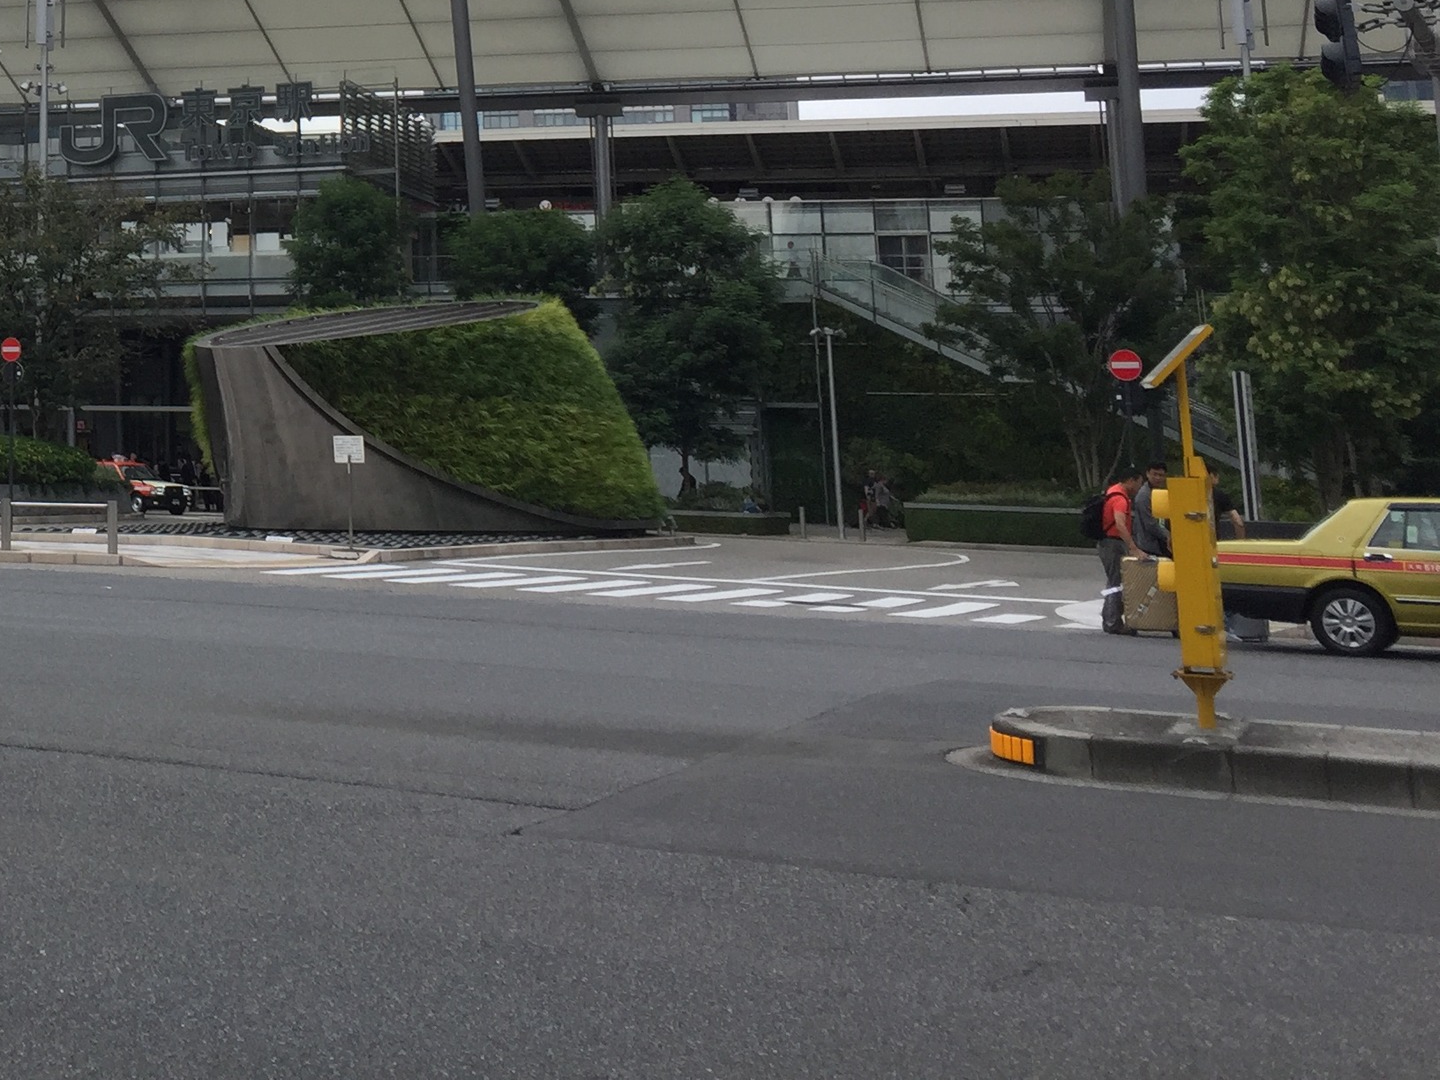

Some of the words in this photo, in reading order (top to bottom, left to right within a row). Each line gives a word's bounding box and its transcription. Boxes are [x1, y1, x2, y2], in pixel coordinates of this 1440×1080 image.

[180, 81, 314, 128] 東京駅
[60, 92, 168, 165] JR
[182, 139, 257, 164] Tokyo
[273, 131, 371, 157] Station
